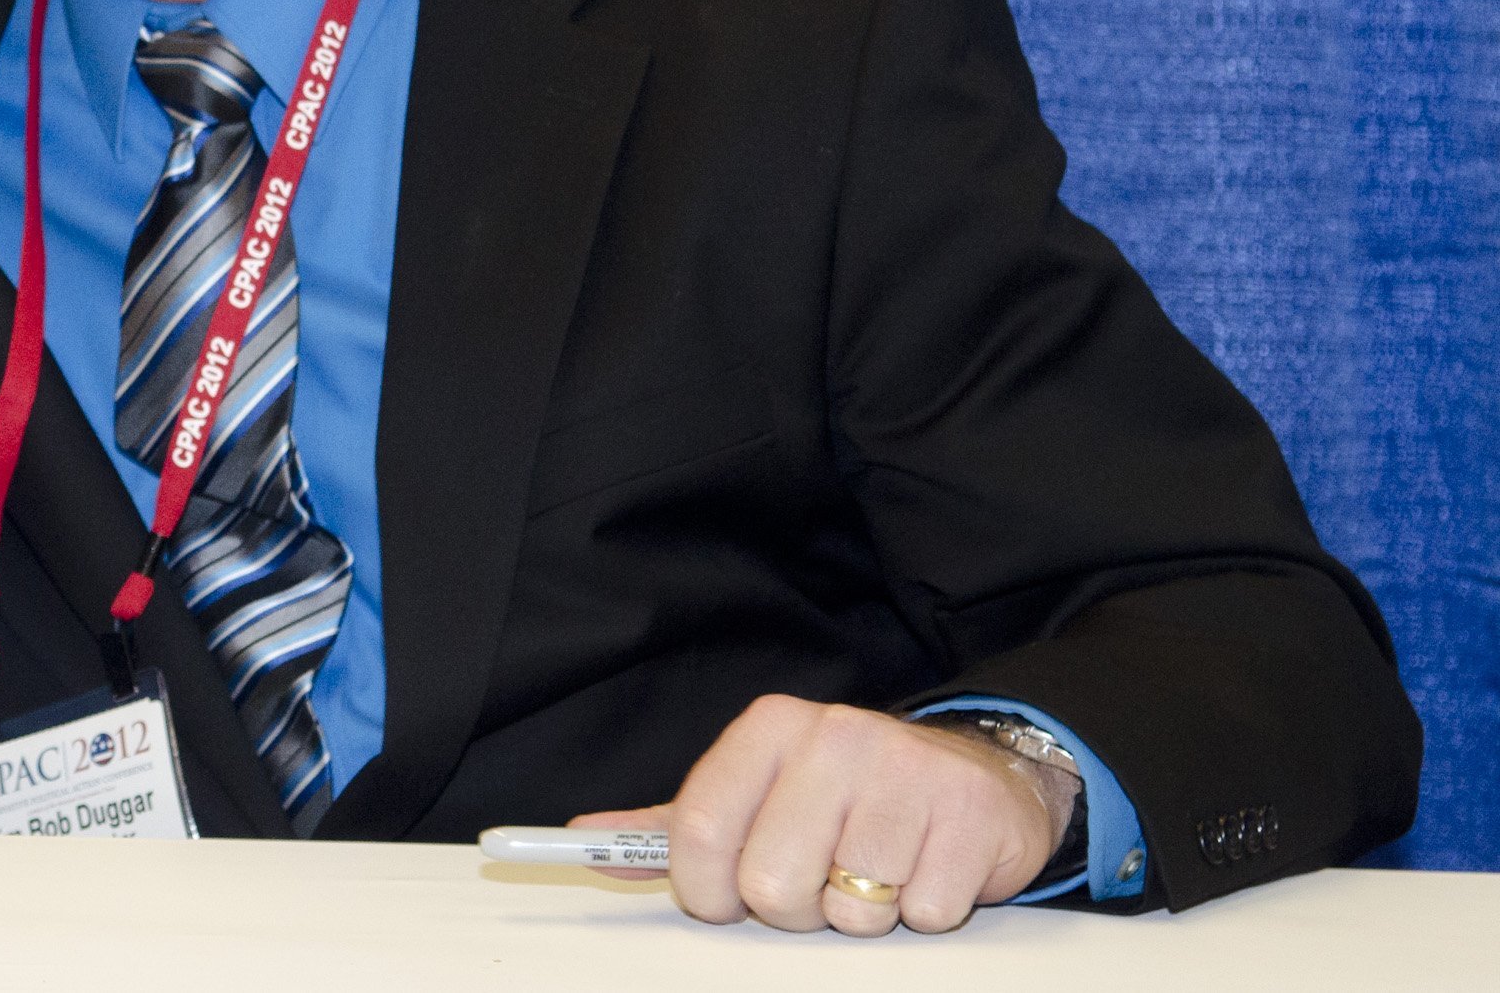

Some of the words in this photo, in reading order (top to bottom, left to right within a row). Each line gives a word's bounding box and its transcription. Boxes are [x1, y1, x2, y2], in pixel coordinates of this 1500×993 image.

[285, 80, 327, 151] CPAC
[314, 19, 348, 82] 2012
[228, 237, 271, 310] CPAC
[255, 176, 293, 239] 2012
[171, 396, 213, 469] CPAC
[196, 336, 235, 398] 2012
[72, 720, 152, 773] 2012
[28, 810, 71, 836] Bob
[77, 790, 154, 829] Duggar
